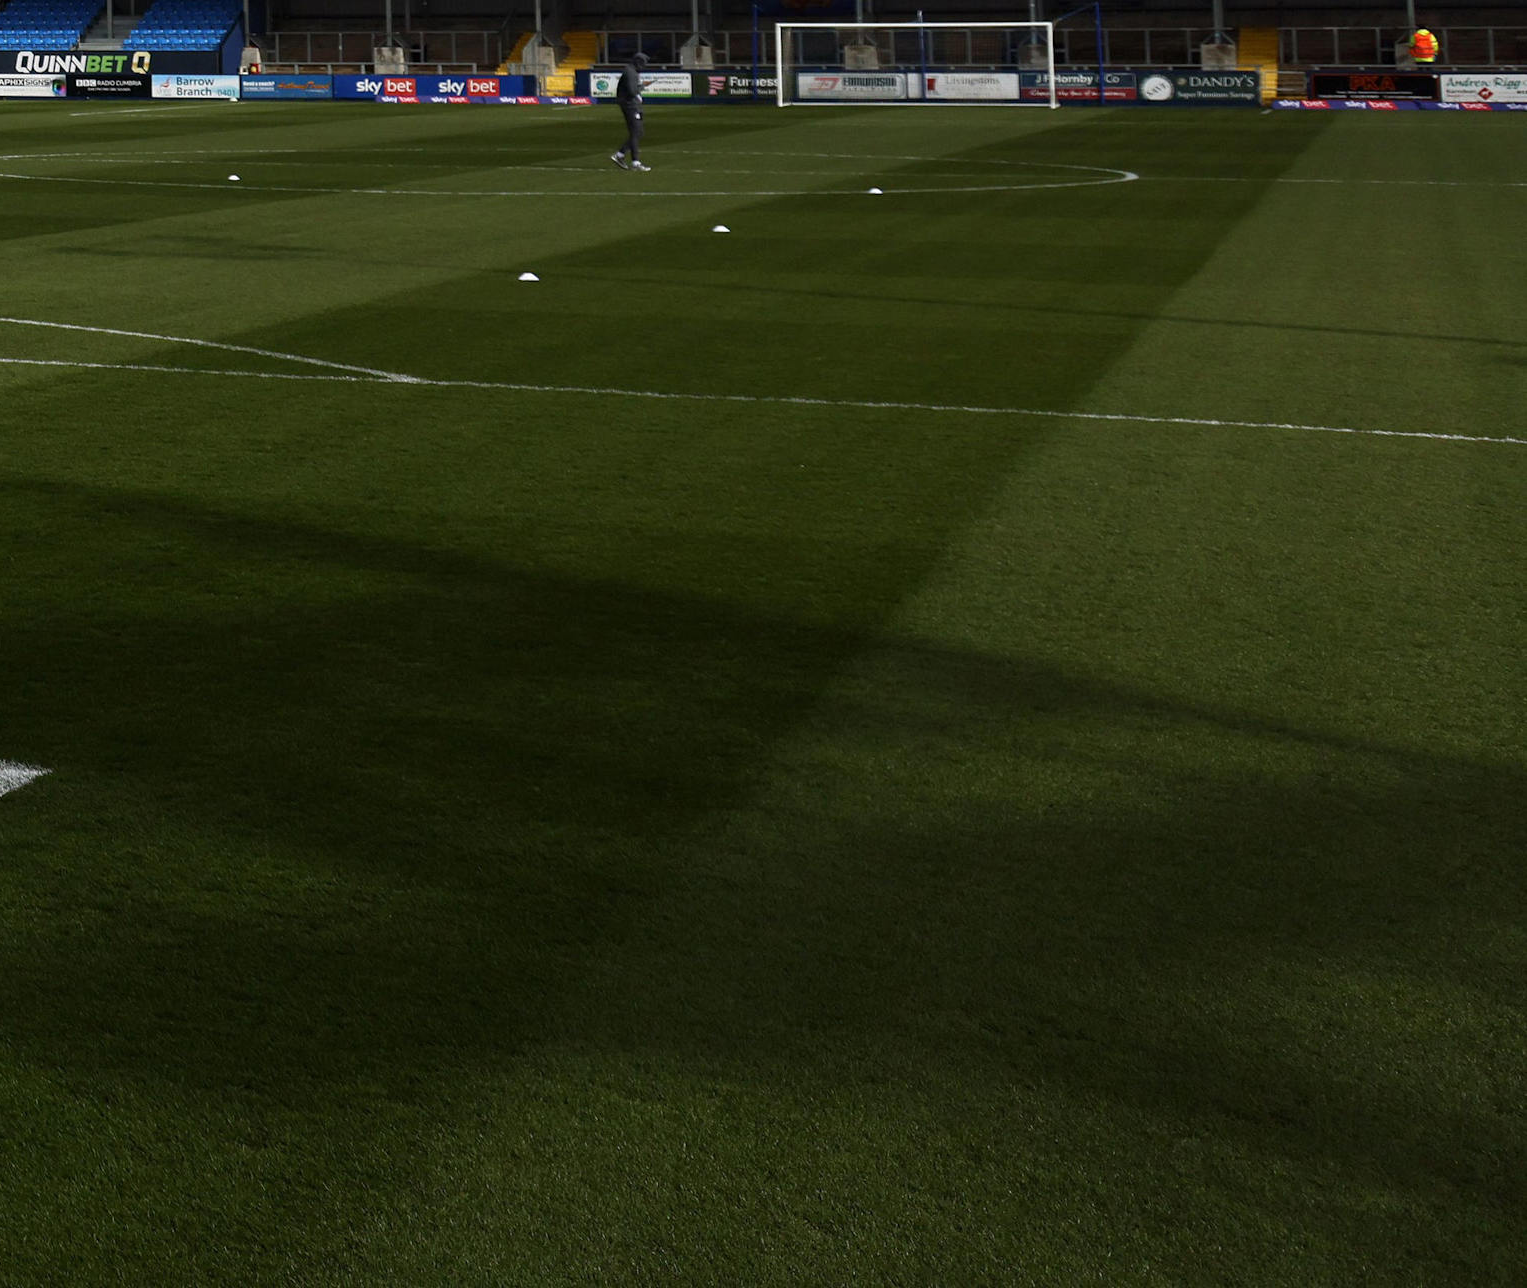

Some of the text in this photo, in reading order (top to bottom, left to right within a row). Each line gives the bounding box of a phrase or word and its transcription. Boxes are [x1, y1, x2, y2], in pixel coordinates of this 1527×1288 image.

[176, 77, 215, 86] Barrow
[1189, 74, 1255, 88] DANDY'S
[356, 78, 412, 95] sky bet
[438, 78, 496, 96] sky bet
[176, 87, 212, 96] Branch
[381, 96, 397, 104] sky
[431, 96, 447, 104] sky
[500, 96, 516, 104] sky
[551, 97, 568, 105] sky
[1278, 100, 1300, 108] sky
[1345, 101, 1366, 109] sky
